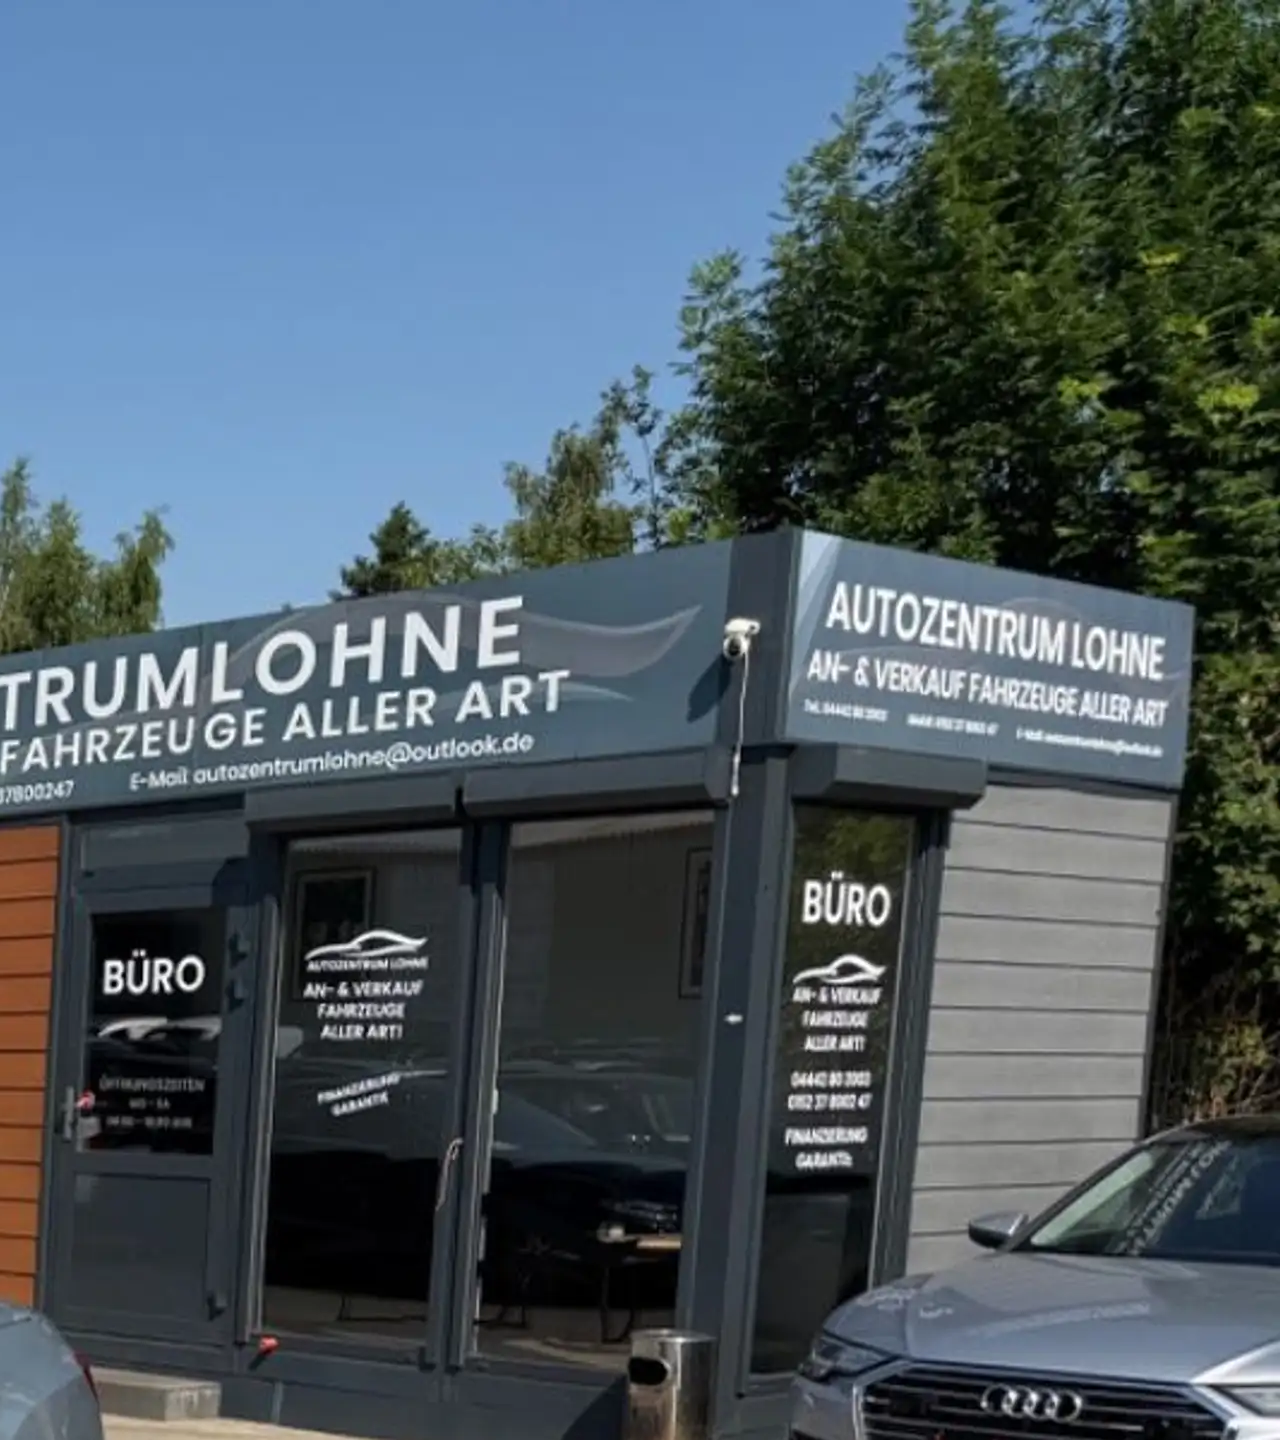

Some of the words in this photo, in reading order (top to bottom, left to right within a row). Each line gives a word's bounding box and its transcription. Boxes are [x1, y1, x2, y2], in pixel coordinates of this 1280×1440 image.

[825, 580, 1066, 666] AUTOZENTRUM
[1071, 622, 1166, 681] LOHNE
[806, 649, 850, 683] AN-
[854, 655, 870, 687] &
[874, 657, 967, 699] VERKAUF
[968, 672, 1079, 716] FAHRZEUGE
[1079, 690, 1131, 724] ALLER
[1132, 698, 1169, 729] ART
[0, 708, 266, 774] FAHRZEUGE
[281, 685, 435, 742] ALLER
[455, 670, 571, 724] ART
[193, 732, 535, 786] autozentrumlohne@outlook.de
[802, 871, 891, 927] BÜRO
[103, 949, 205, 995] BÜRO
[303, 981, 335, 999] AN-
[337, 981, 349, 998] &
[352, 979, 423, 998] VERKAUF
[317, 1002, 405, 1019] FAHRZEUGE
[320, 1023, 365, 1040] ALLER
